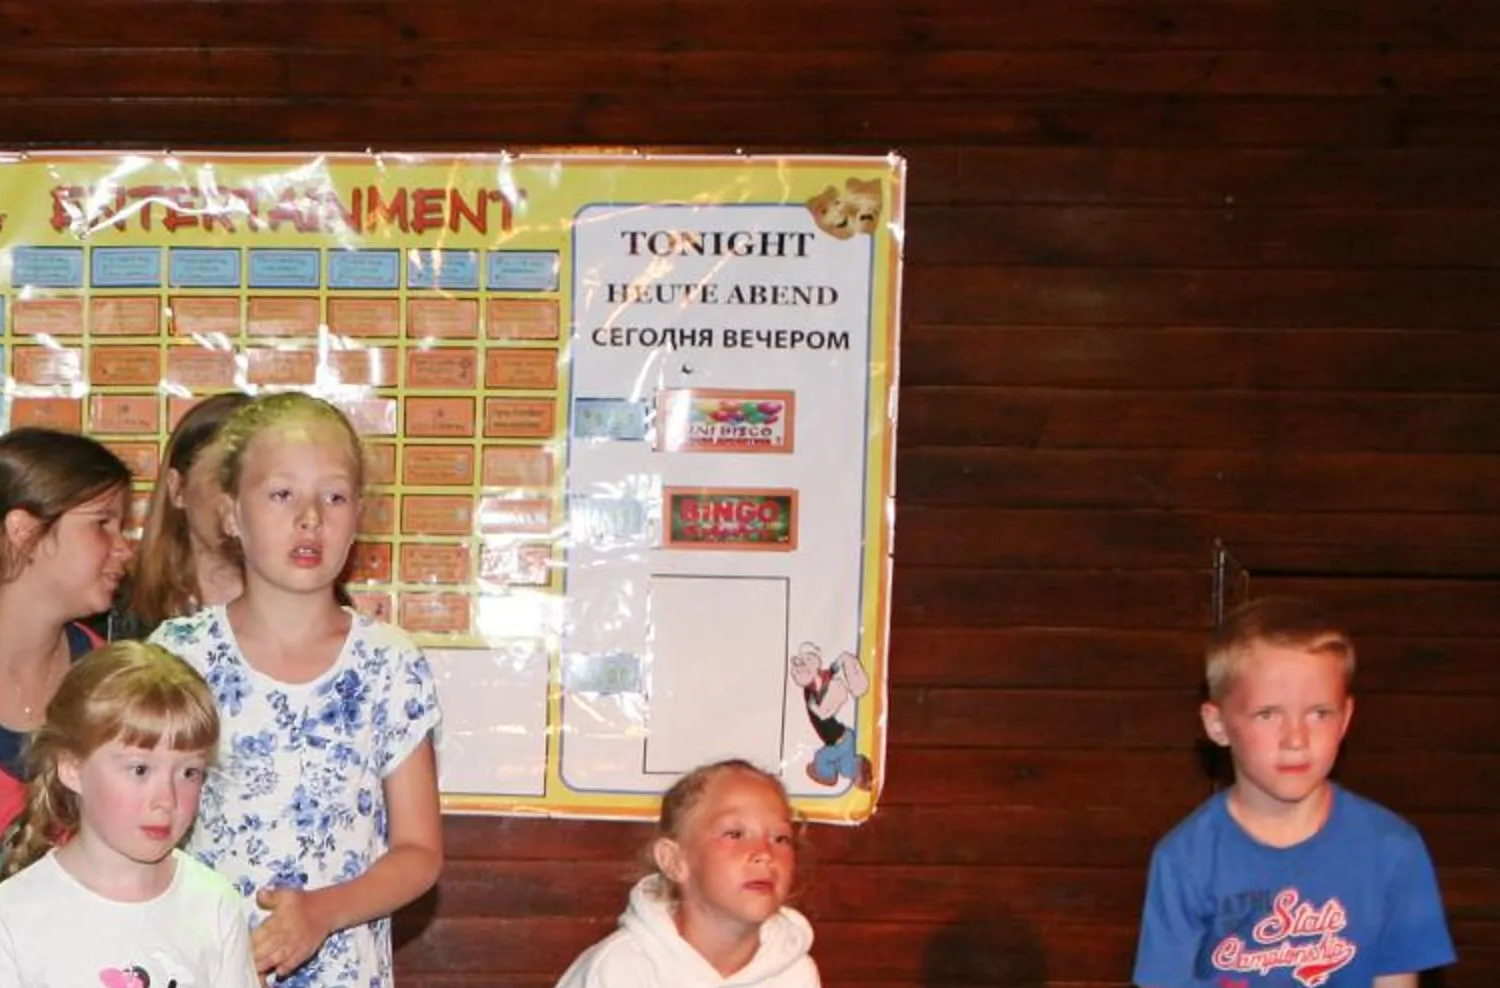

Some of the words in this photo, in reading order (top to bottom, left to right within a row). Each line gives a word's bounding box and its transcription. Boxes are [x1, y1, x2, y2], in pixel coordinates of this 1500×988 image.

[621, 230, 815, 258] TONIGHT
[607, 283, 719, 305] HEUTE
[726, 284, 839, 307] ABEND
[592, 327, 714, 351] СЕГОДНЯ
[723, 328, 850, 350] ВЕЧЕРОМ
[680, 498, 780, 523] BINGO
[1252, 888, 1348, 945] State
